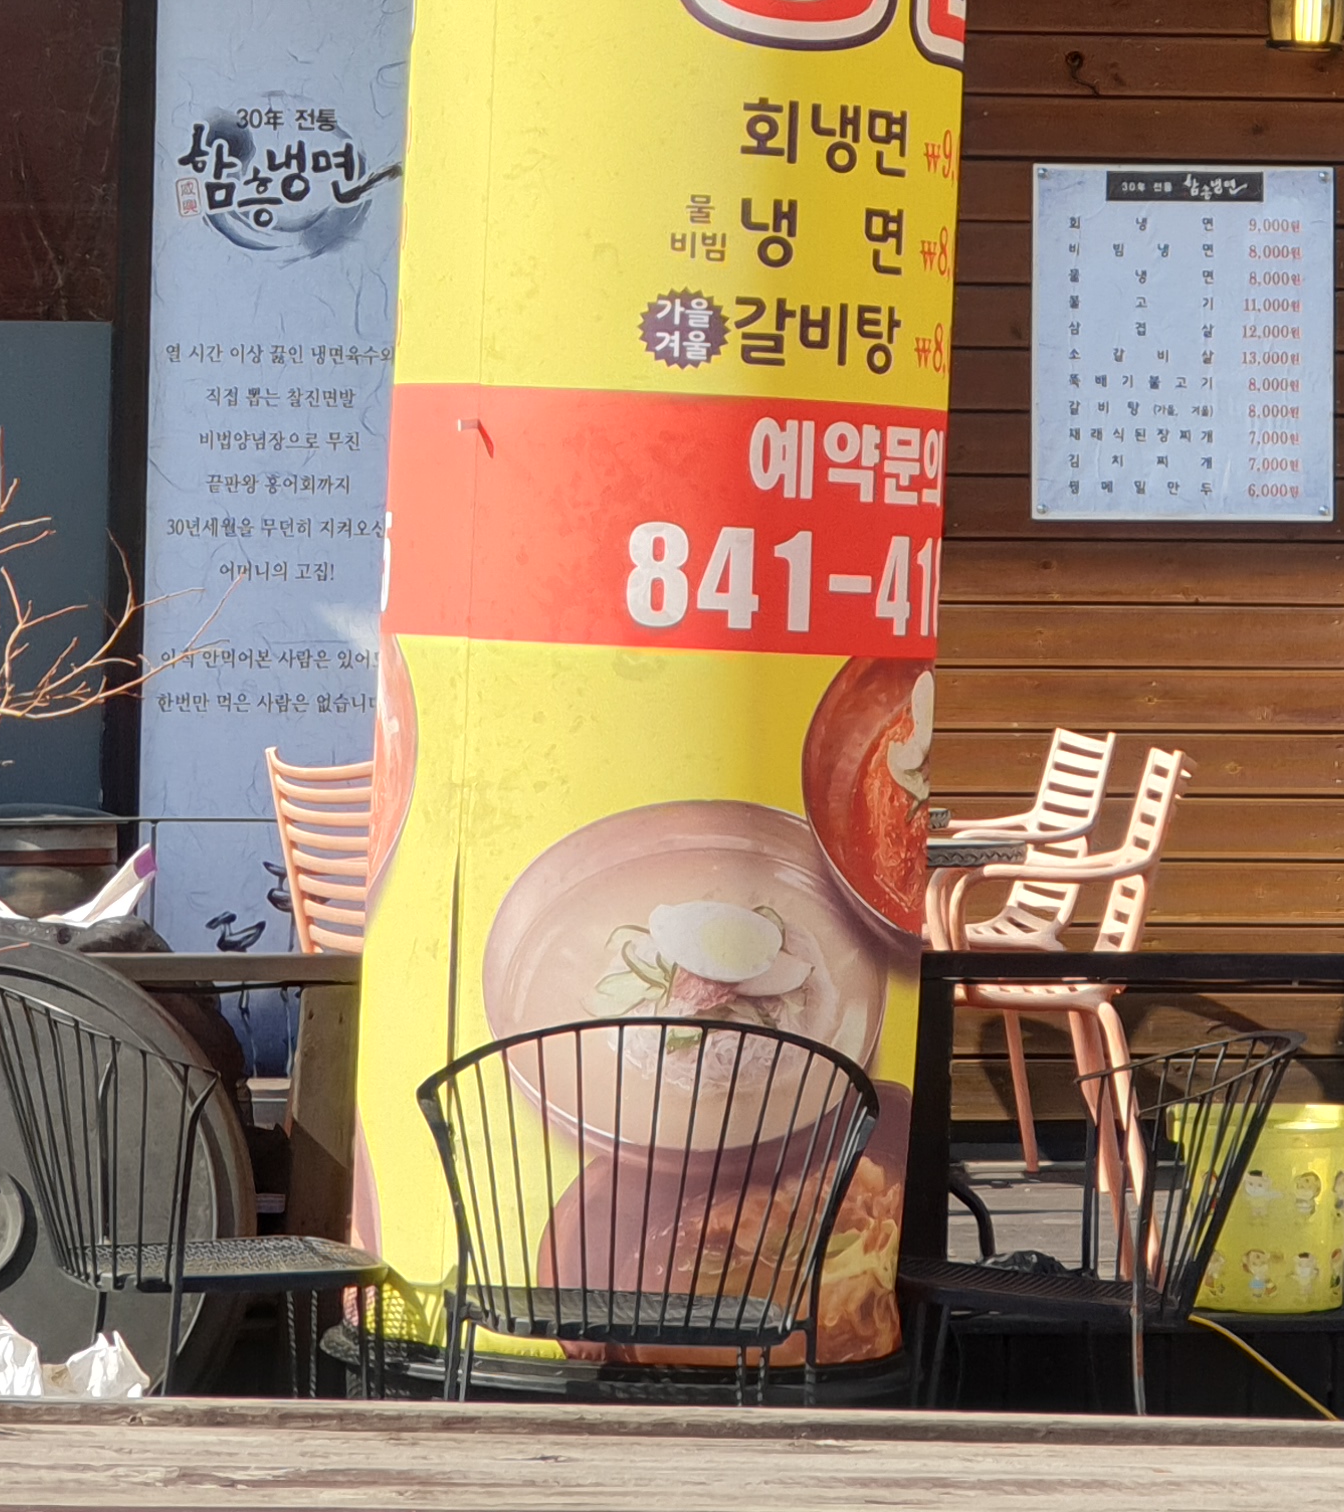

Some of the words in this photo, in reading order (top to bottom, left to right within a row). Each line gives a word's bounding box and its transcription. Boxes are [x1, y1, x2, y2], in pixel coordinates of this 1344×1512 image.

[295, 108, 337, 132] 전통
[740, 96, 908, 179] 회냉면
[685, 193, 716, 225] 물
[669, 230, 728, 263] 비빔
[656, 297, 714, 329] 가을
[654, 330, 712, 361] 겨울
[734, 295, 902, 375] 갈비탕
[165, 343, 182, 364] 열
[188, 344, 223, 364] 시간
[229, 344, 264, 365] 이상
[269, 345, 304, 365] 끓인
[205, 386, 239, 408] 직접
[245, 386, 281, 408] 뽑는
[286, 387, 356, 409] 찰진면발
[198, 429, 320, 452] 비법양념장으로
[325, 431, 361, 452] 무친
[748, 416, 945, 508] 예약문의
[205, 474, 259, 496] 끝판왕
[260, 516, 312, 538] 무던히
[294, 561, 335, 582] 고집!
[624, 520, 943, 637] 841-41
[277, 648, 331, 670] 사람은
[157, 692, 210, 713] 한번만
[216, 692, 251, 713] 먹은
[256, 692, 310, 714] 사람은
